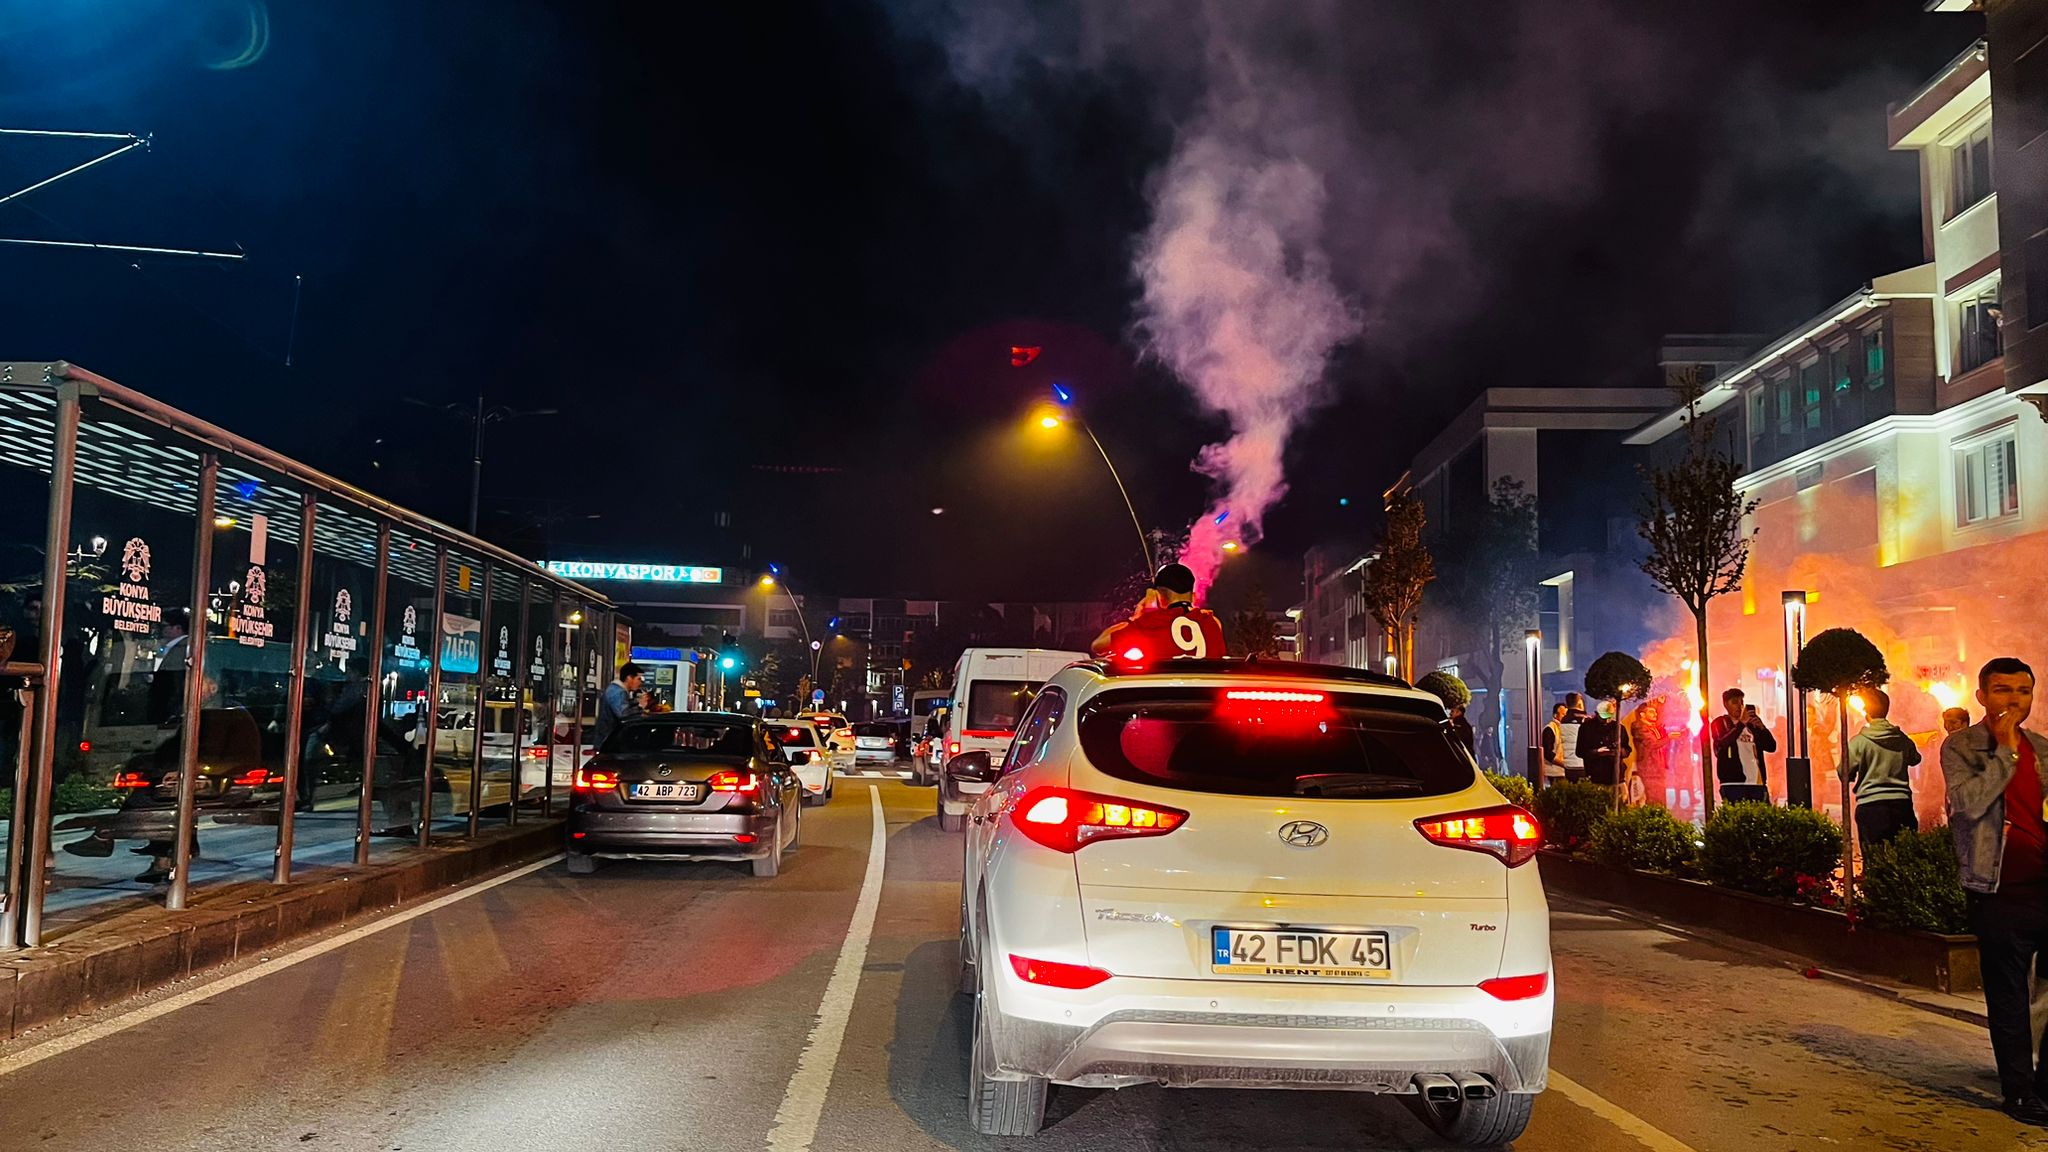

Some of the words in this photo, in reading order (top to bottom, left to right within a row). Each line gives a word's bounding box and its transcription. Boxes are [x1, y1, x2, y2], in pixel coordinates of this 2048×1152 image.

[568, 563, 676, 581] KONYASPOR
[119, 582, 149, 600] KONYA
[102, 595, 162, 622] BÜYÜKŞEHİR
[243, 604, 265, 619] KONYA
[113, 619, 150, 634] BELEDİYESİ
[1171, 616, 1207, 659] 9
[637, 785, 650, 797] 42
[656, 785, 674, 797] ABP
[678, 785, 696, 797] 723
[1470, 923, 1497, 932] Turbo
[1217, 949, 1230, 958] TR
[1231, 933, 1266, 963] 42
[1276, 935, 1339, 965] FDK
[1351, 937, 1385, 967] 45
